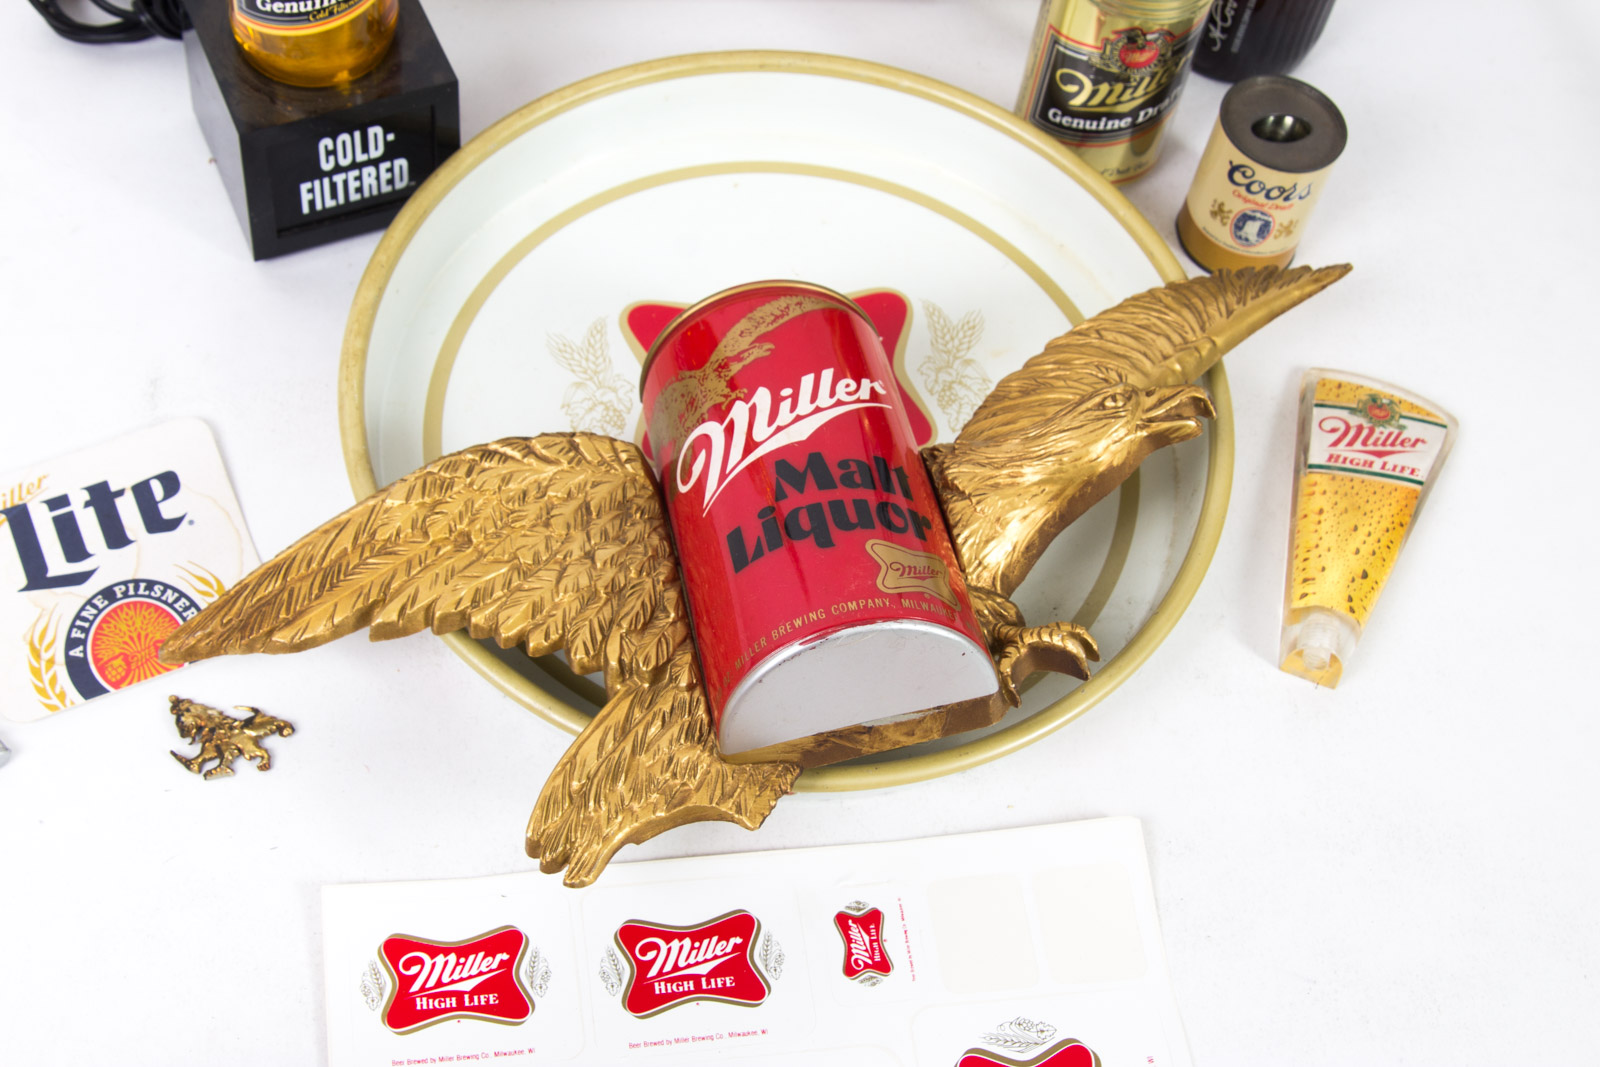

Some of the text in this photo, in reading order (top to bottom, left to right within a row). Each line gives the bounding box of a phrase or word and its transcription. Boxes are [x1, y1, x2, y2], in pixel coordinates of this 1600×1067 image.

[255, 0, 343, 14] Genuin
[1047, 107, 1133, 131] Genuine
[318, 124, 396, 172] COLD-
[299, 157, 410, 215] FILTERED
[1227, 160, 1313, 202] Coors
[676, 367, 891, 515] Miller
[1318, 416, 1428, 449] Miller
[774, 451, 913, 502] Malt
[1325, 453, 1421, 477] HIGH LIFE
[1, 473, 50, 510] iller
[0, 470, 187, 592] Lite
[726, 498, 932, 574] Liquor
[889, 562, 943, 577] Miller
[69, 582, 199, 658] A FINE PILSNER
[734, 637, 768, 671] MILLER
[771, 608, 826, 640] BREWING
[831, 598, 897, 616] COMPANY,
[635, 935, 743, 979] Miller
[848, 919, 873, 971] Miller
[398, 950, 510, 993] Miller
[653, 976, 735, 995] HIGH LIFE
[415, 993, 499, 1011] HIGH LIFE
[391, 1059, 405, 1067] Beer
[406, 1057, 429, 1066] Brewed
[438, 1055, 455, 1063] Miller
[456, 1053, 480, 1062] Brewing
[628, 1041, 641, 1049] Beer
[643, 1039, 665, 1048] Brewed
[673, 1036, 690, 1044] Miller
[691, 1033, 714, 1042] Brewing
